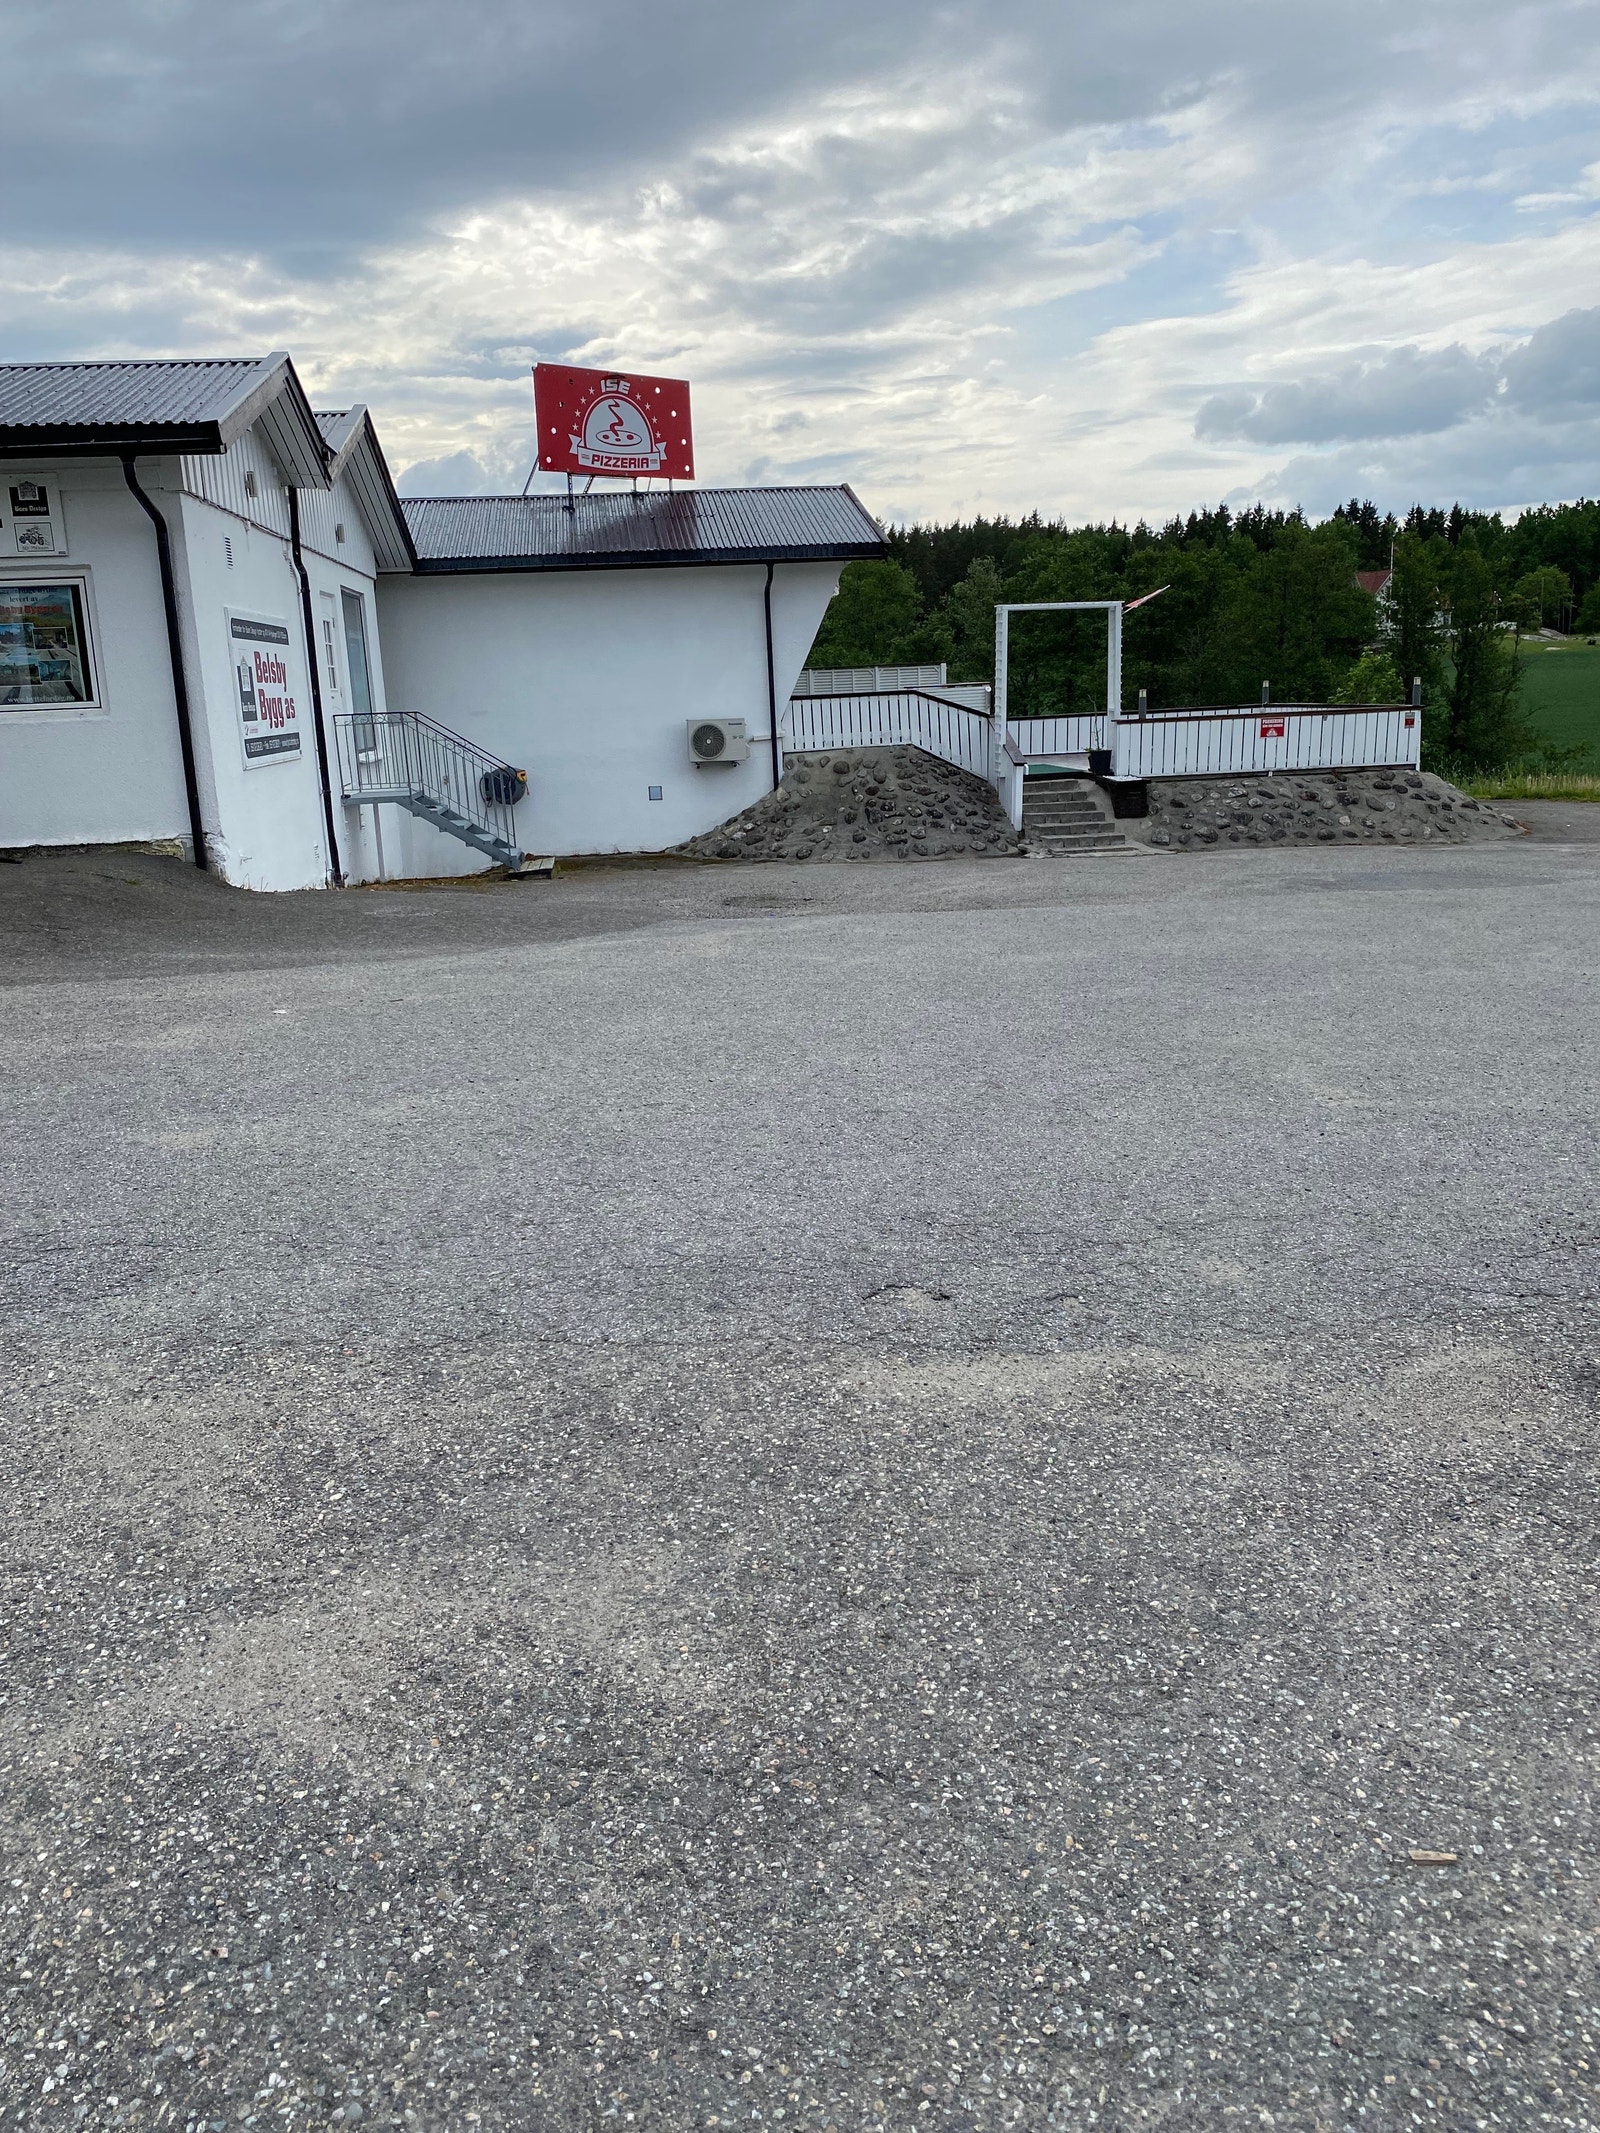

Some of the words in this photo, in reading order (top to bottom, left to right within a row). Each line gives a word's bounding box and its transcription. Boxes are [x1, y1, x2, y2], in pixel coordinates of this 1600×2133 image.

[601, 379, 631, 395] ISE
[591, 454, 649, 469] PIZZERIA
[254, 651, 286, 692] Belsby
[258, 689, 284, 729] Bygg
[285, 698, 296, 719] as
